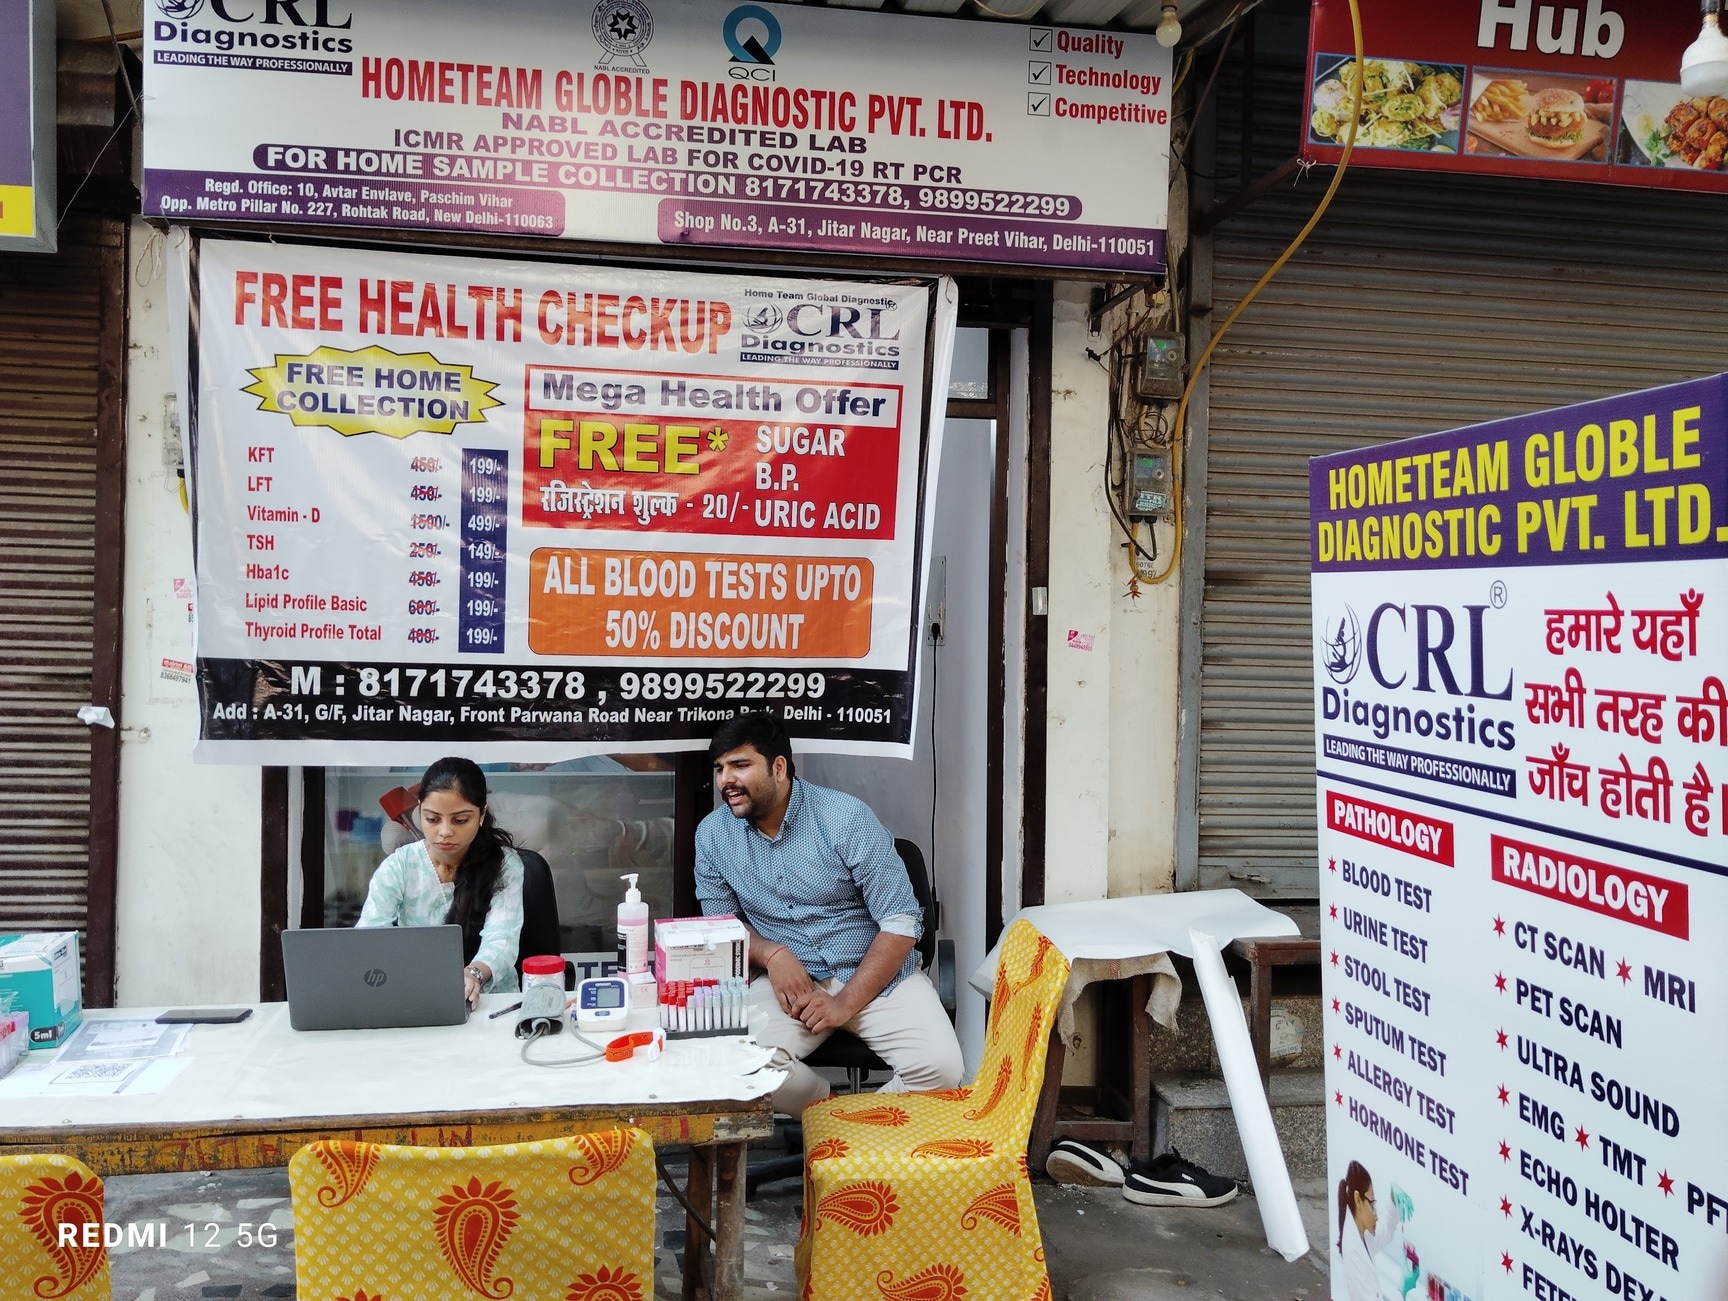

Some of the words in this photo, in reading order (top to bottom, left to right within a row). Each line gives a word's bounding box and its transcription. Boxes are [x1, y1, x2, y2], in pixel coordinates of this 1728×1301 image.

[154, 20, 353, 54] Diagnostics
[1057, 30, 1124, 59] Quality
[1476, 0, 1625, 59] Hub
[157, 52, 206, 65] LEADING
[256, 58, 348, 73] PROFESSIONALLY
[612, 66, 650, 75] ACCREDITED
[728, 66, 776, 82] QCI
[1055, 64, 1161, 95] Technology
[361, 56, 542, 110] HOMETEAM
[555, 70, 668, 119] GLOBLE
[680, 79, 857, 133] DIAGNOSTIC
[868, 93, 926, 138] PVT.
[937, 99, 993, 143] LTD.
[1055, 97, 1167, 125] Competitive
[502, 112, 587, 136] NABL
[599, 119, 798, 149] ACCREDITED
[809, 134, 867, 154] LAB
[394, 128, 464, 151] ICMR
[473, 134, 618, 162] APPROVED
[747, 153, 864, 178] COVID-19
[913, 164, 962, 184] PCR
[205, 178, 243, 196] Regd.
[248, 180, 292, 196] Office:
[323, 184, 358, 200] Avtar
[362, 186, 416, 204] Envlave,
[420, 190, 475, 207] Paschim
[479, 193, 513, 209] Vihar
[432, 156, 548, 183] SAMPLE
[558, 165, 736, 195] COLLECTION
[745, 175, 911, 210] 8171743378,
[919, 188, 1070, 216] 9899522299
[160, 195, 192, 212] Opp.
[196, 196, 236, 212] Metro
[241, 198, 277, 214] Pillar
[307, 201, 338, 218] 227,
[342, 204, 389, 219] Rohtak
[393, 206, 430, 223] Road,
[465, 208, 553, 229] Delhi-110063
[674, 209, 714, 233] Shop
[719, 214, 763, 236] No.3,
[768, 216, 813, 239] A-31,
[817, 219, 855, 241] Jitar
[860, 221, 911, 246] Nagar,
[958, 228, 999, 248] Preet
[1004, 231, 1047, 253] Vihar,
[1052, 233, 1155, 257] Delhi-110051
[235, 270, 344, 332] FREE
[359, 278, 522, 343] HEALTH
[537, 289, 731, 355] CHECKUP
[744, 289, 774, 299] Home
[777, 291, 804, 300] Team
[807, 293, 838, 302] Global
[786, 303, 900, 341] CRL
[741, 334, 900, 357] Diagnostics
[287, 362, 364, 387] FREE
[374, 367, 461, 393] HOME
[542, 373, 646, 410] Mega
[660, 379, 782, 413] Health
[795, 386, 886, 417] Offer
[276, 390, 469, 421] COLLECTION
[248, 446, 275, 463] KFT
[469, 457, 501, 475] 199/-
[756, 425, 845, 457] SUGAR
[1329, 441, 1509, 511] HOMETEAM
[1525, 406, 1701, 489] GLOBLE
[247, 476, 273, 493] LFT
[469, 486, 501, 503] 199/-
[755, 462, 799, 490] B.P.
[247, 504, 299, 523] Vitamin
[311, 507, 321, 523] D
[467, 514, 500, 532] 499/-
[632, 489, 679, 525] शुल्क
[754, 499, 816, 529] URIC
[822, 502, 880, 531] ACID
[1318, 504, 1502, 562] DIAGNOSTIC
[1517, 495, 1606, 554] PVT.
[1625, 484, 1728, 549] LTD.
[247, 534, 275, 551] TSH
[467, 542, 500, 560] 149/-
[246, 563, 290, 580] Hba1c
[467, 571, 499, 589] 199/-
[543, 555, 595, 595] ALL
[604, 557, 696, 598] BLOOD
[704, 560, 788, 600] TESTS
[795, 564, 861, 601] UPTO
[245, 593, 278, 613] Lipid
[282, 594, 327, 612] Profile
[331, 595, 367, 612] Basic
[466, 599, 498, 616] 199/-
[245, 621, 297, 642] Thyroid
[301, 623, 344, 641] Profile
[348, 625, 382, 641] Total
[466, 628, 498, 645] 199/-
[605, 609, 660, 650] 50%
[669, 611, 805, 650] DISCOUNT
[1544, 591, 1624, 655] हमारे
[1631, 587, 1704, 662] यहाँ
[1366, 602, 1514, 701] CRL
[358, 667, 585, 699] 8171743378
[619, 672, 826, 700] 9899522299
[263, 703, 309, 723] A-31,
[352, 704, 393, 722] Jitar
[399, 705, 455, 726] Nagar,
[460, 706, 505, 723] Front
[510, 706, 583, 724] Parwana
[677, 706, 734, 721] Trikona
[784, 705, 822, 721] Delhi
[837, 706, 891, 724] 110051
[1322, 686, 1516, 751] Diagnostics
[1524, 667, 1586, 729] सभी
[1594, 689, 1666, 744] तरह
[1676, 676, 1728, 747] की
[1326, 738, 1366, 761] LEADING
[1410, 754, 1510, 792] PROFESSIONALLY
[1526, 742, 1590, 807] जाँच
[1599, 752, 1673, 824] होती
[1334, 799, 1442, 855] PATHOLOGY
[1503, 846, 1669, 923] RADIOLOGY
[1343, 907, 1388, 947] URINE
[1391, 926, 1428, 963] TEST
[1514, 921, 1538, 953] CT
[1544, 932, 1605, 980] SCAN
[366, 969, 385, 988] hp
[1644, 965, 1696, 1014] MRI
[34, 1029, 53, 1040] 5ml
[1345, 1002, 1405, 1055] SPUTUM
[1408, 1034, 1446, 1077] TEST
[1517, 1035, 1583, 1093] ULTRA
[1590, 1072, 1680, 1138] SOUND
[1519, 1092, 1565, 1143] EMG
[1599, 1135, 1647, 1187] TMT
[1521, 1149, 1577, 1207] ECHO
[1585, 1187, 1680, 1272] HOLTER
[1521, 1204, 1599, 1280] X-RAYS
[1606, 1260, 1668, 1301] DEX
